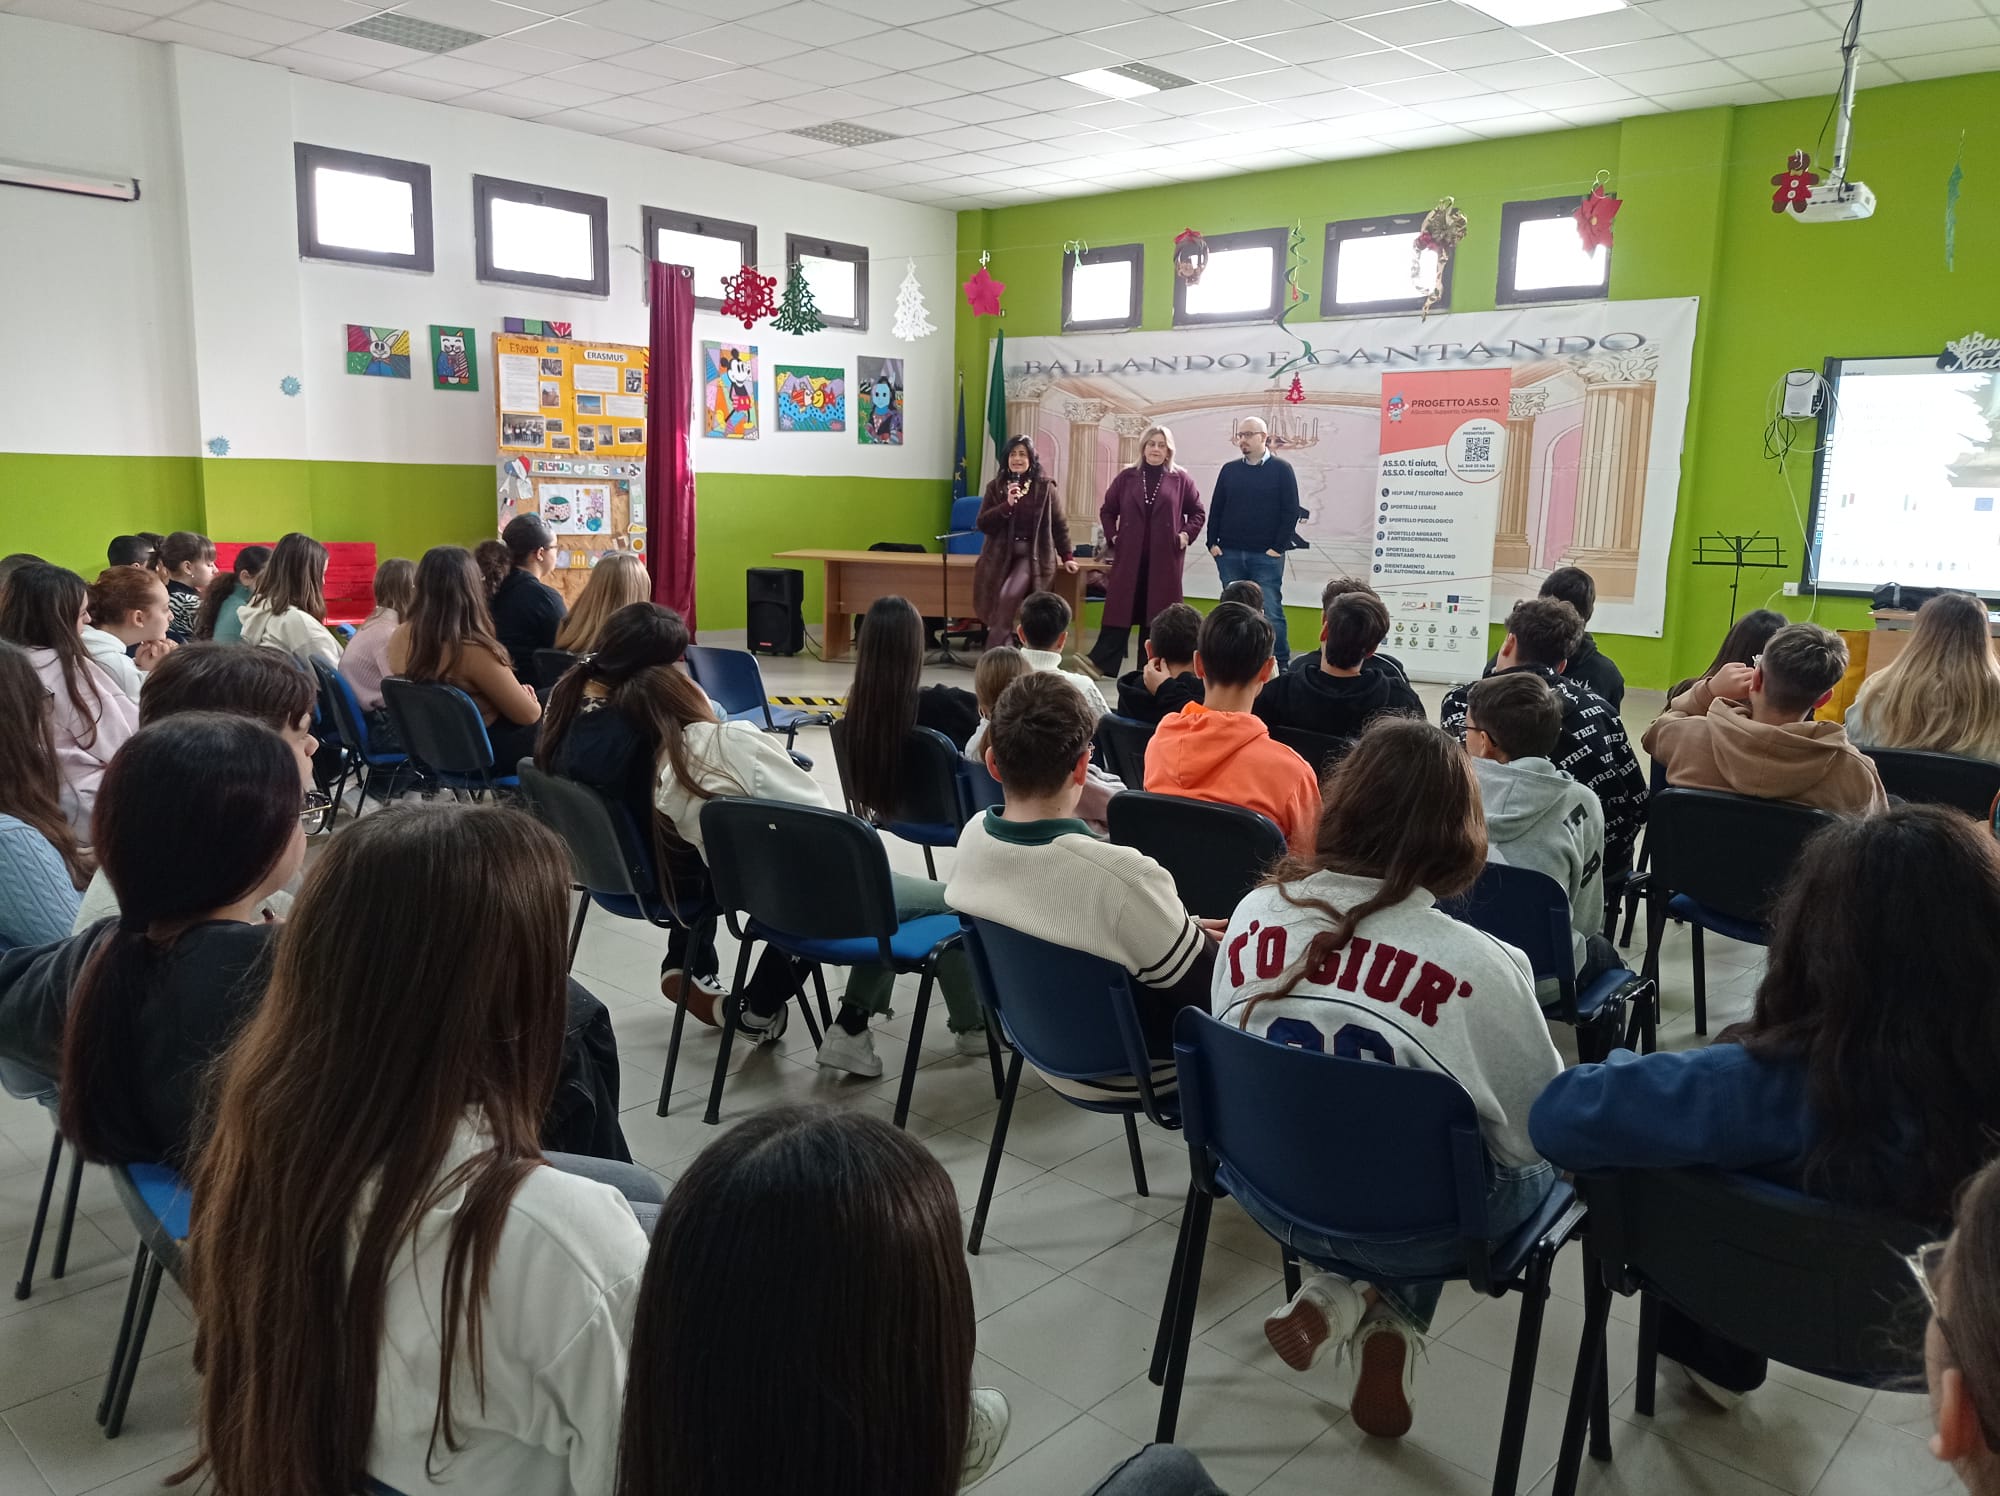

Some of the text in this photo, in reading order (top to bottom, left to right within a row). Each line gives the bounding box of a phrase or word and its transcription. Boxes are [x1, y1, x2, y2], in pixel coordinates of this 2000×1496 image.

[587, 351, 625, 361] ERASMUS
[1023, 353, 1251, 374] BALLANDO
[1307, 332, 1647, 366] CANTANDO
[1411, 399, 1465, 408] PROGETTO
[1408, 459, 1414, 467] ti
[1415, 459, 1438, 468] aiuta,
[1407, 469, 1414, 477] ti
[1414, 469, 1447, 477] ascolta!
[1571, 724, 1598, 740] YREX
[1560, 745, 1593, 770] PYREX
[1619, 758, 1638, 777] REX
